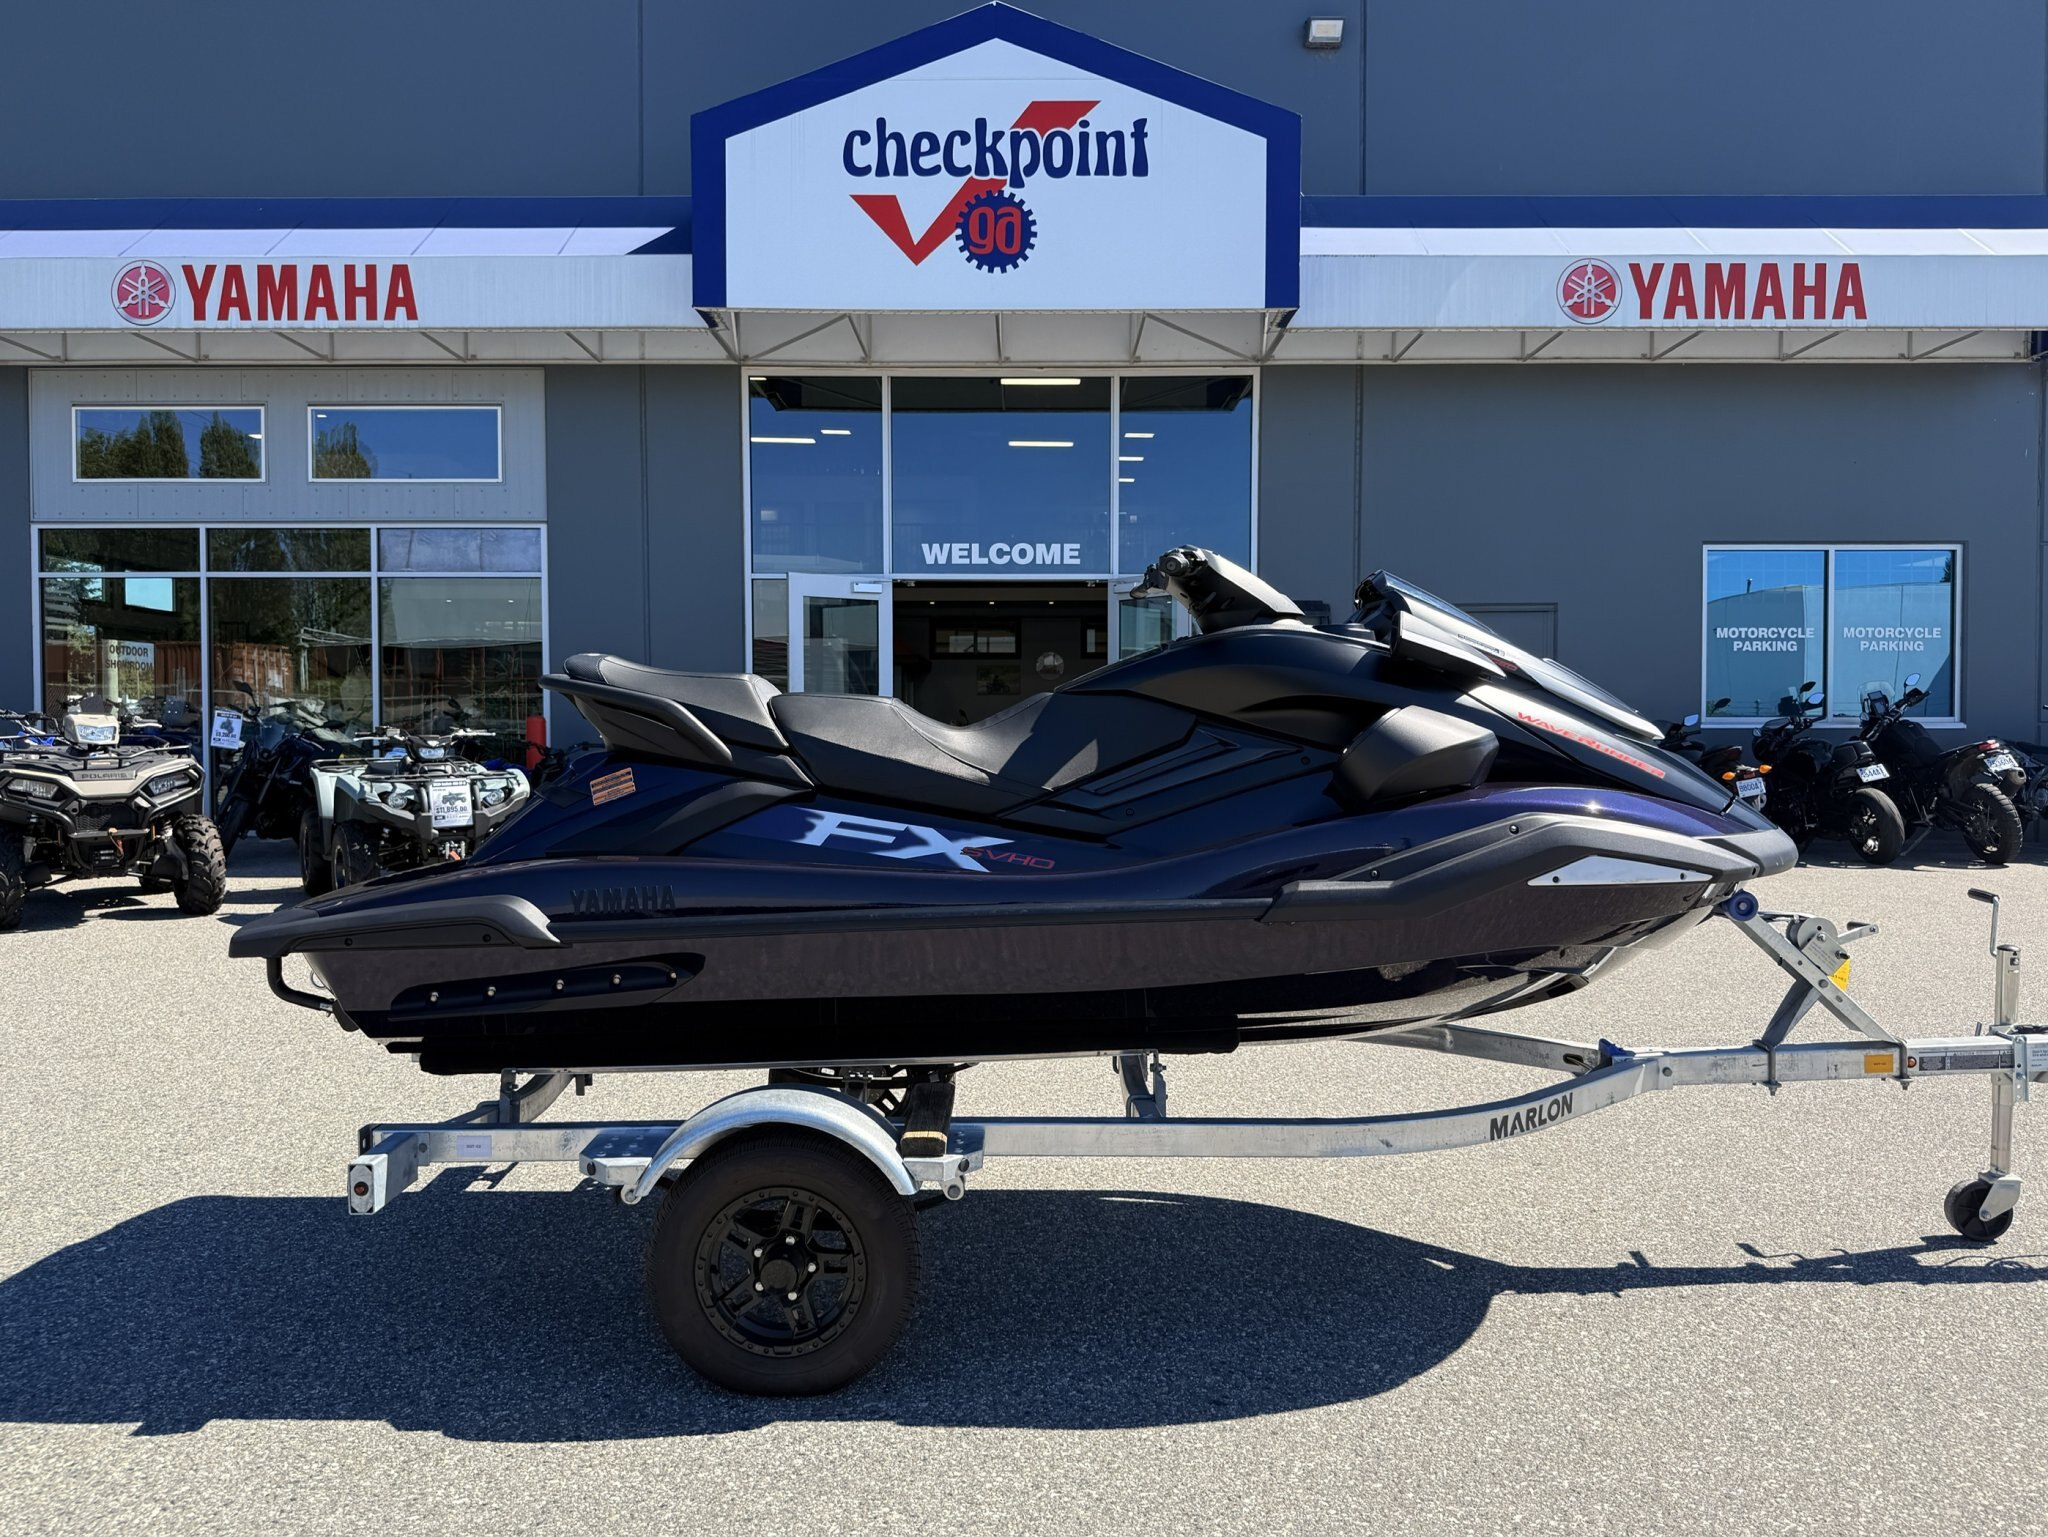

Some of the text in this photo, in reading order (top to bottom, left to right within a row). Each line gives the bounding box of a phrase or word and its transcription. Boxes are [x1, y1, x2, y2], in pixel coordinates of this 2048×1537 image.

[843, 117, 1148, 188] checkpoint
[181, 264, 418, 321] YAMAHA
[1628, 263, 1867, 320] YAMAHA
[921, 543, 1081, 565] WELCOME
[1716, 627, 1815, 638] MOTORCYCLE
[1843, 627, 1942, 638] MOTORCYCLE
[109, 645, 149, 657] OUTDOOR
[1733, 641, 1798, 652] PARKING
[1860, 641, 1924, 652] PARKING
[105, 660, 153, 671] SHOWROOM
[791, 806, 1016, 873] FX
[959, 847, 1056, 870] SVHO
[569, 885, 676, 914] YAMAHA
[1490, 1092, 1574, 1141] MARLON
